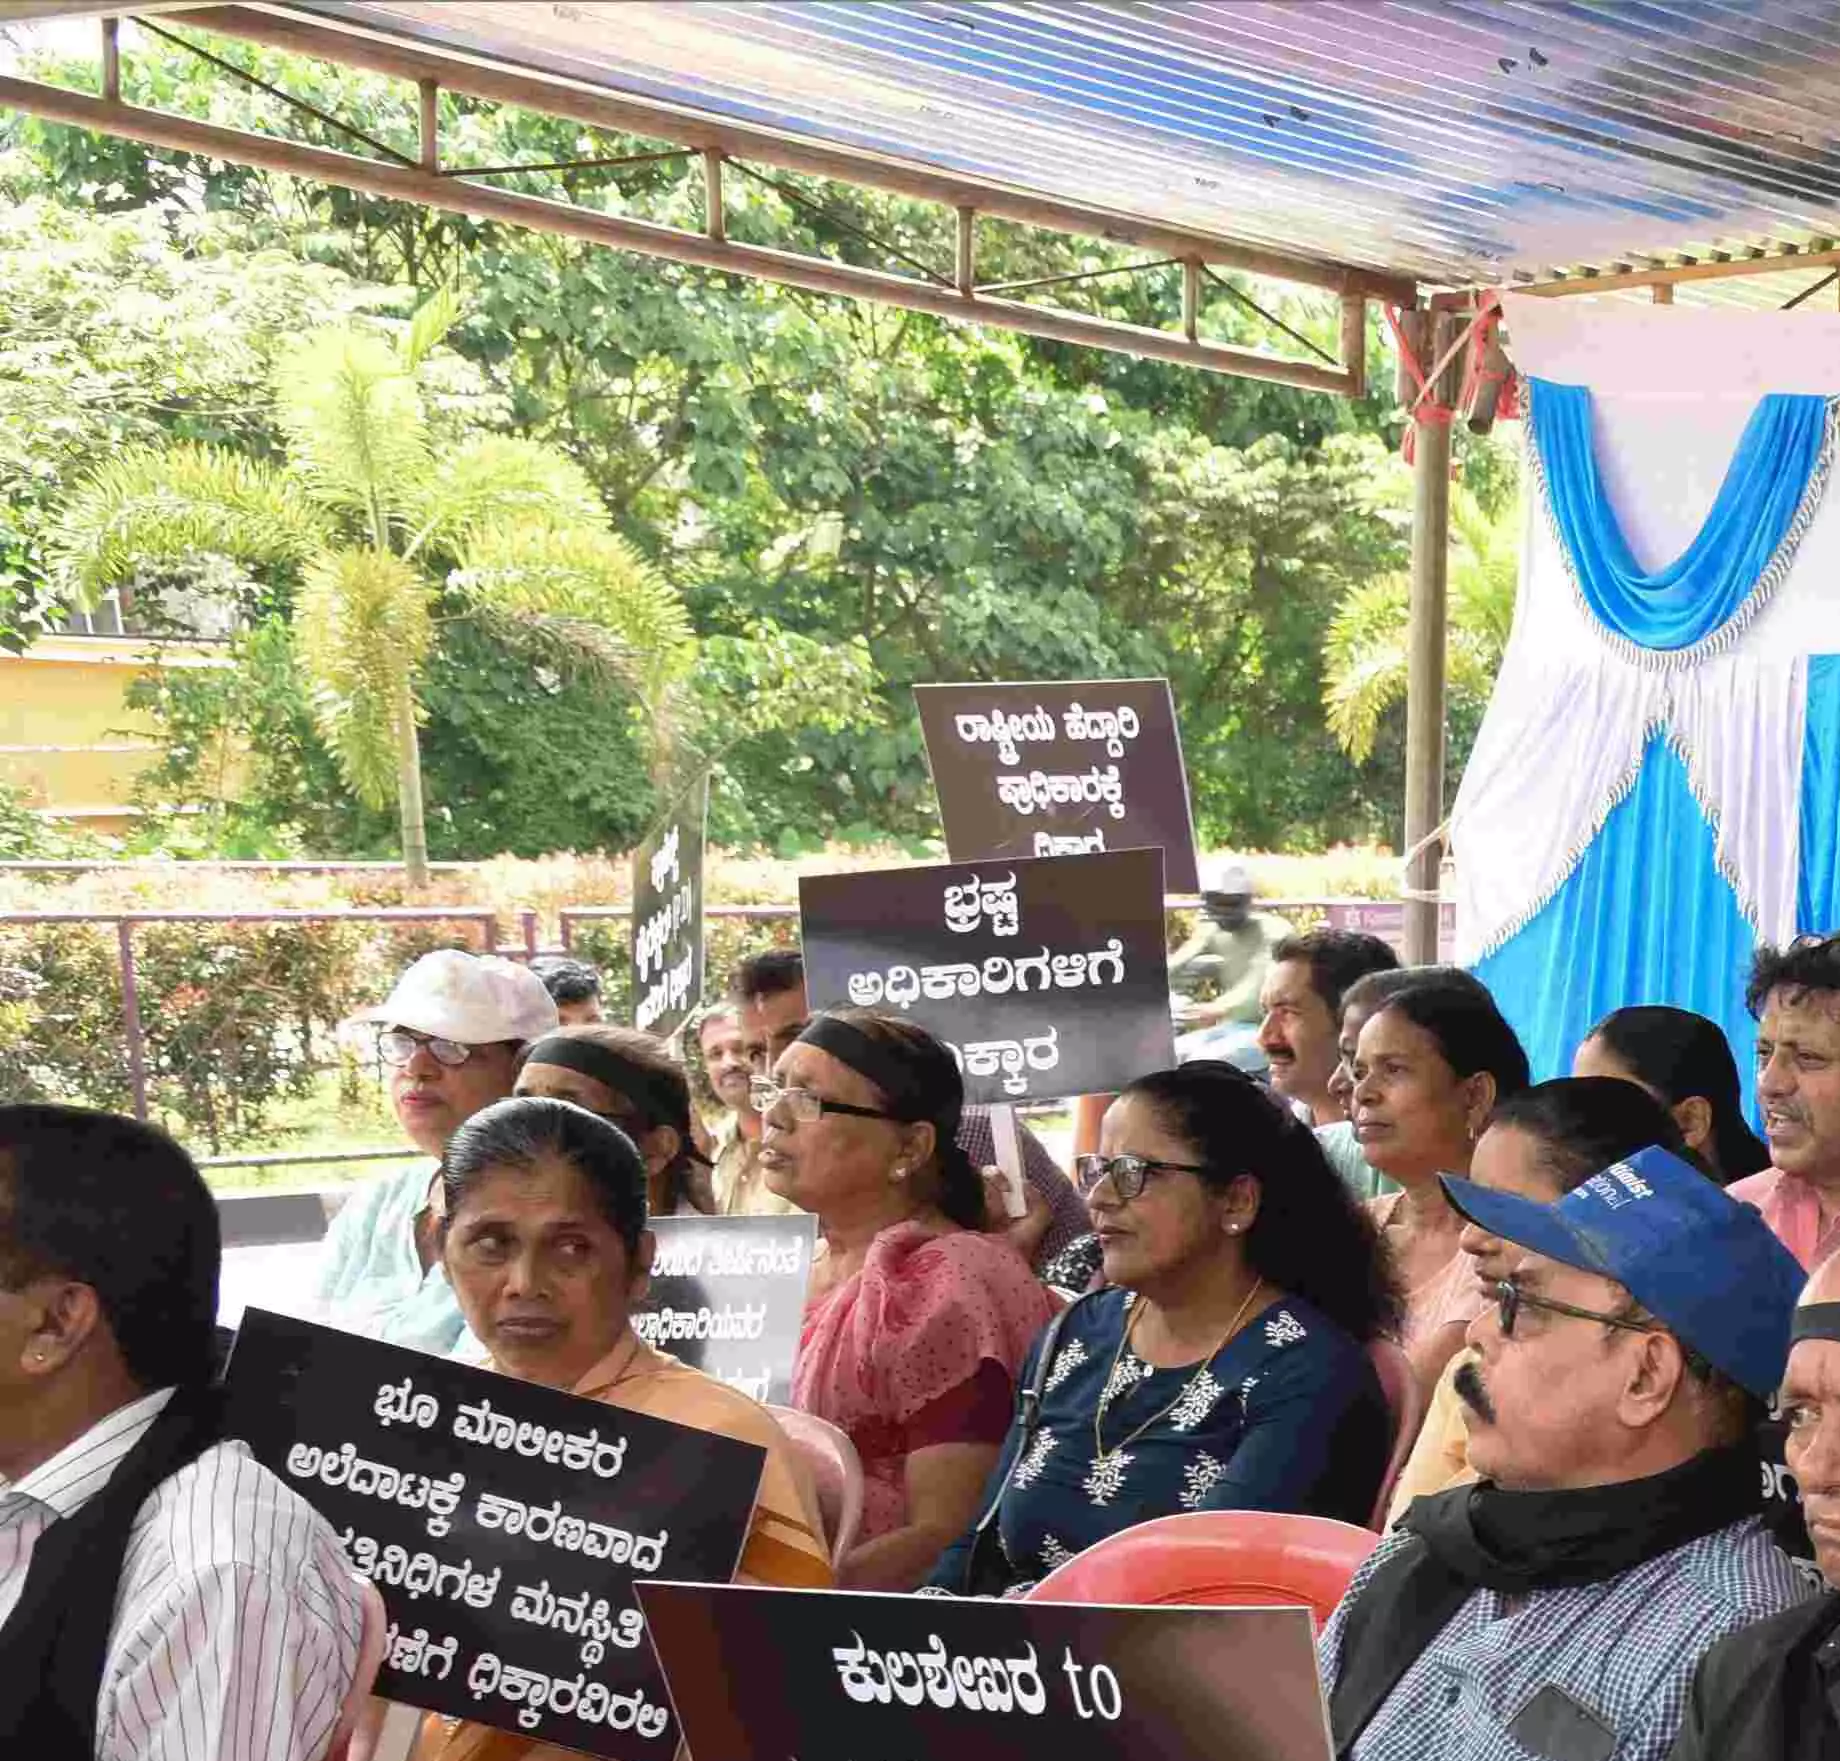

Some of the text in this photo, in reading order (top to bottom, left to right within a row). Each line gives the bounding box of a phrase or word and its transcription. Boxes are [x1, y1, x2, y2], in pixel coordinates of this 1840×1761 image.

[954, 701, 1140, 766] ರಾಷ್ಟ್ರೀಯ ಹೆದ್ದಾರಿ
[996, 764, 1126, 820] ಪ್ರಾಧಿಕಾರಕ್ಕೆ
[942, 870, 1019, 937] ಭ್ರಷ್ಟ
[847, 936, 1126, 1010] ಅಧಿಕಾರಿಗಳಿಗೆ
[944, 1025, 1060, 1095] ಕ್ಕಾರ
[373, 1376, 628, 1481] ಭೂ ಮಾಲೀಕರ
[286, 1437, 668, 1574] ಅಲೆದಾಟಕ್ಕೆ ಕಾರಣವಾದ
[336, 1526, 645, 1669] ತಿನಿಧಿಗಳ ಮನಸ್ಥಿತಿ
[468, 1649, 669, 1741] ಧಿಕ್ಕಾರವಿರಲಿ
[832, 1629, 1121, 1721] ಕುಲಶೇಖರ to
